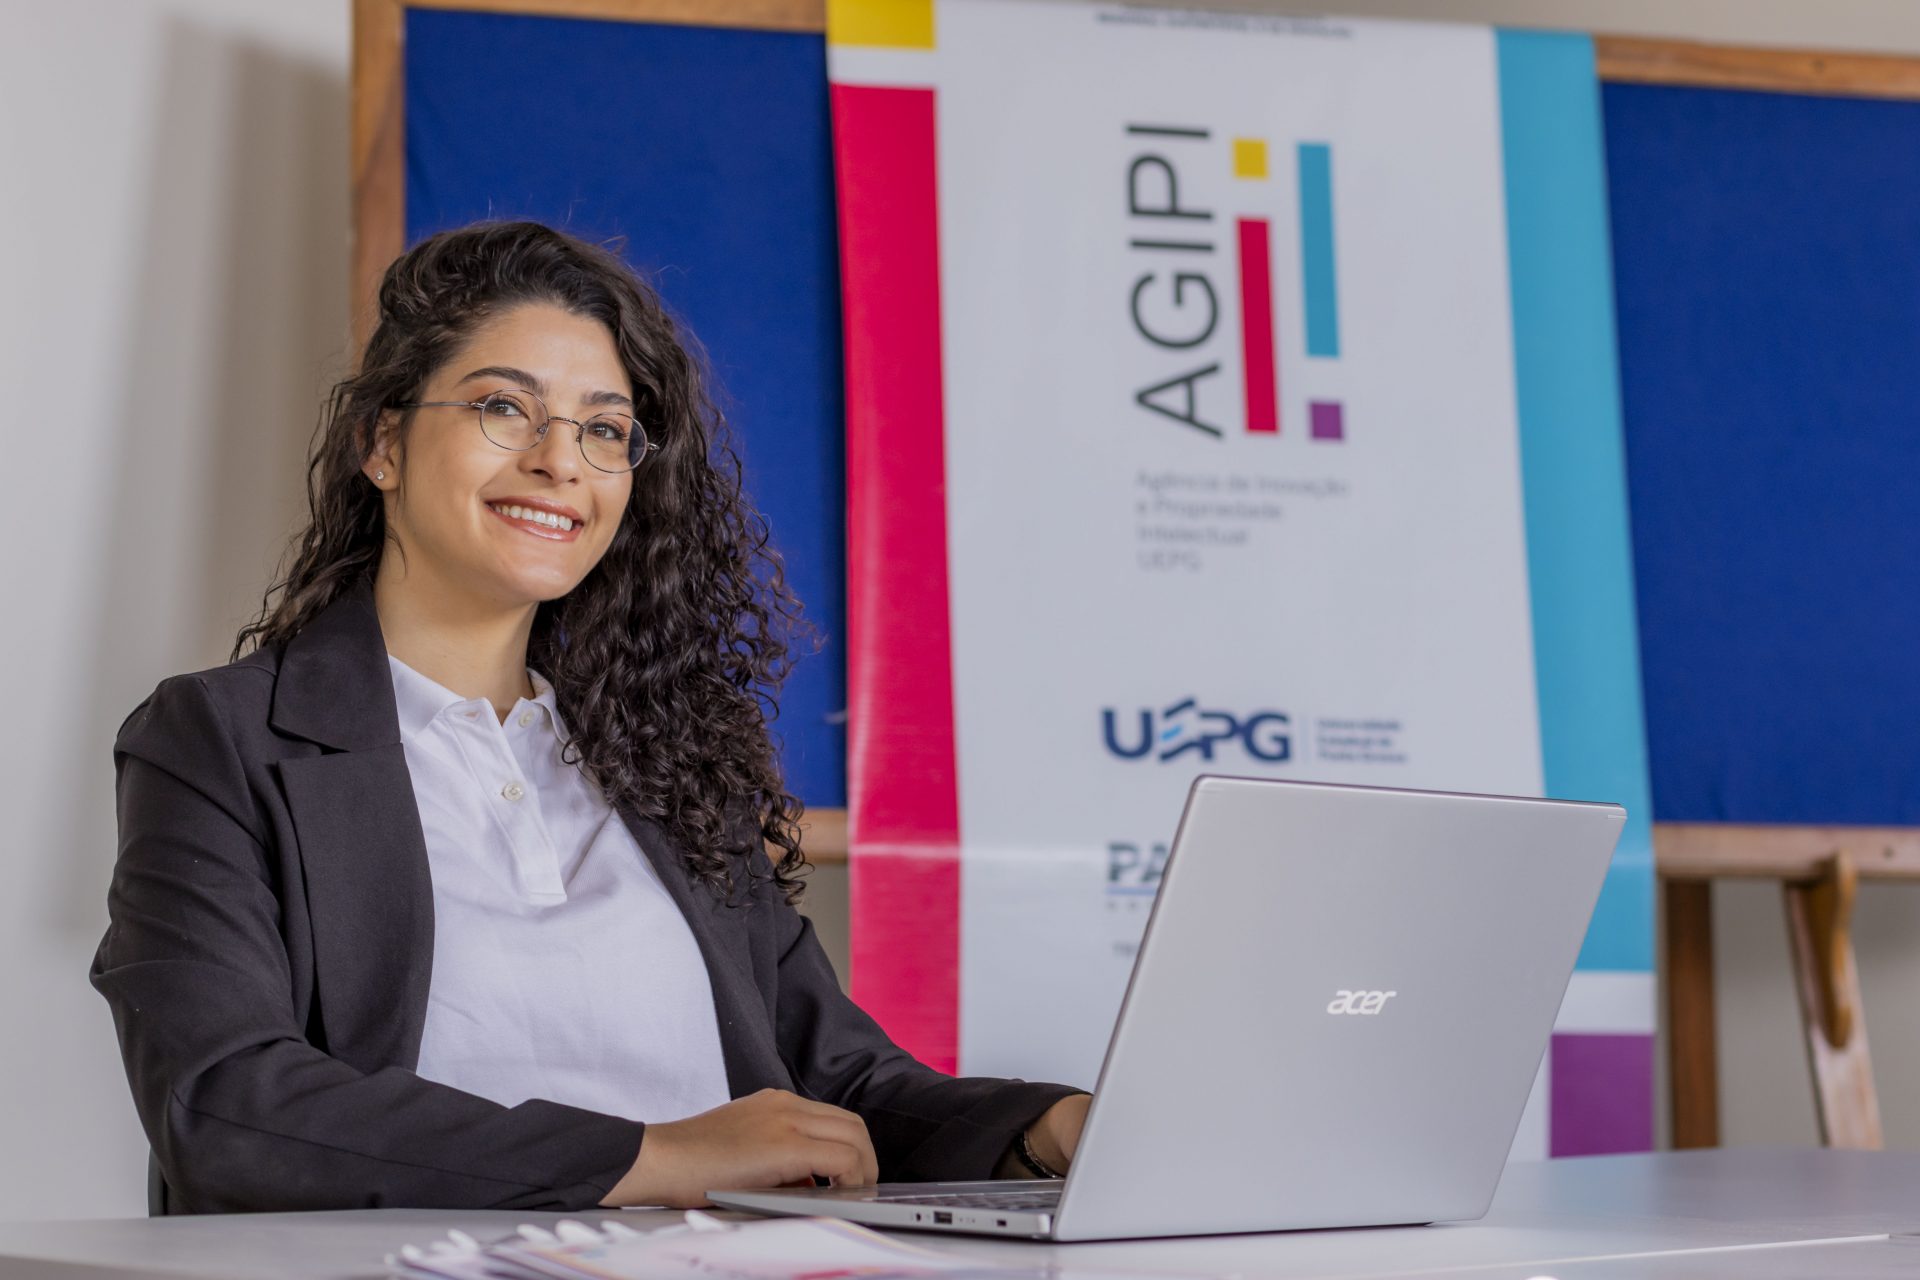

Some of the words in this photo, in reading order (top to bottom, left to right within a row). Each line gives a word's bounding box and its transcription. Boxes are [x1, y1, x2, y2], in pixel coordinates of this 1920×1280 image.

[1126, 123, 1223, 440] AGIPI
[1102, 697, 1291, 763] UEPG
[1327, 990, 1397, 1015] acer
